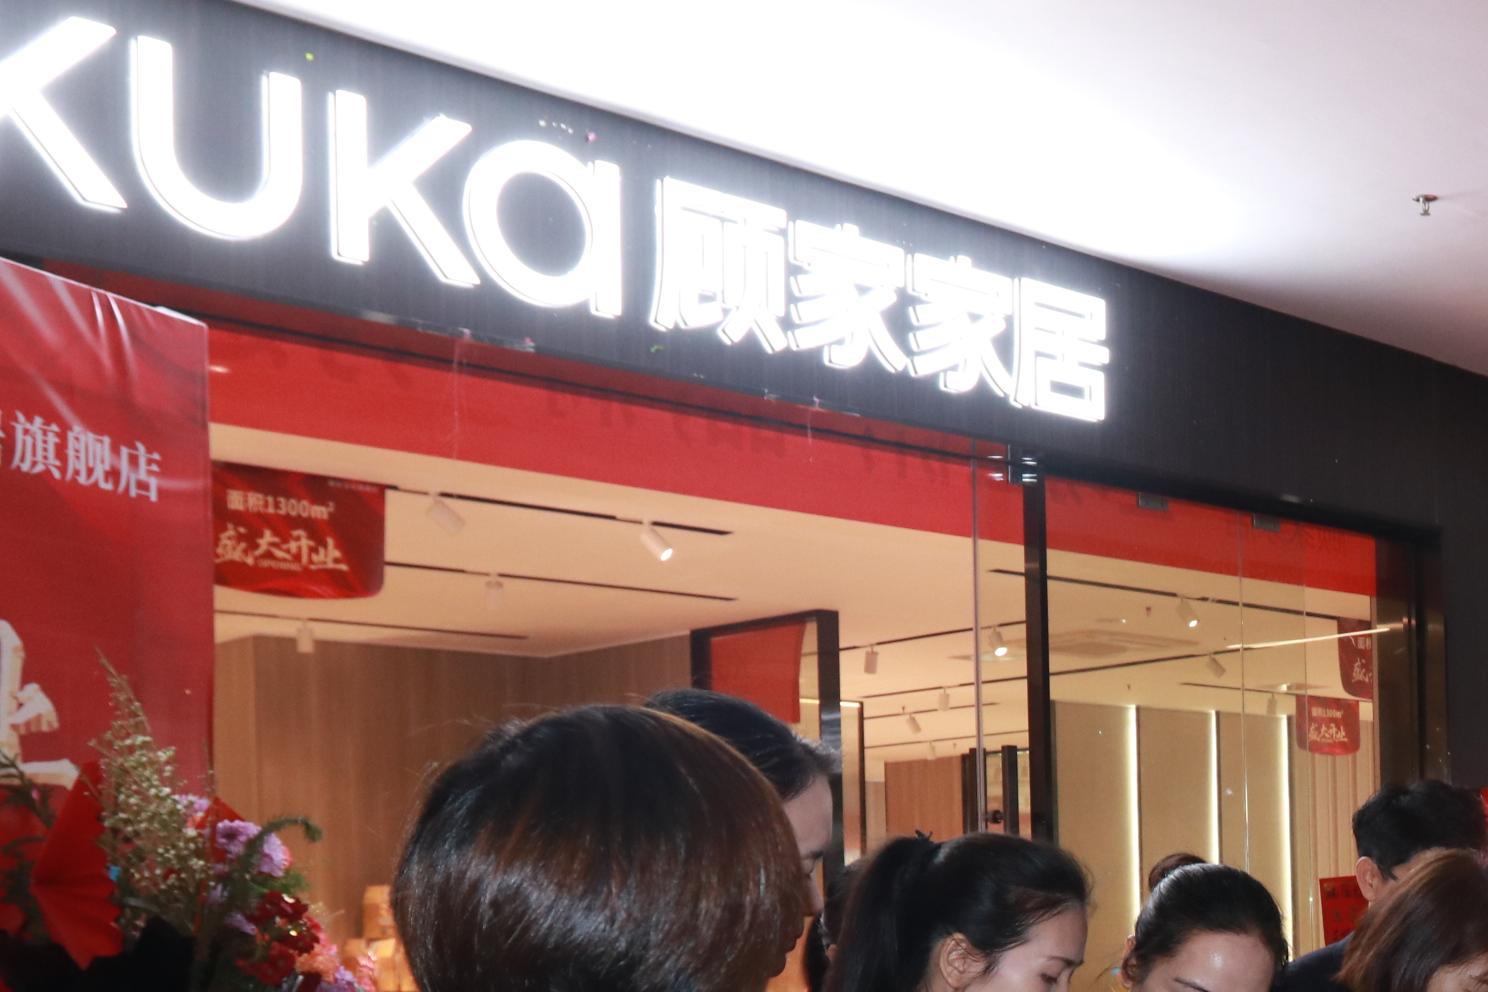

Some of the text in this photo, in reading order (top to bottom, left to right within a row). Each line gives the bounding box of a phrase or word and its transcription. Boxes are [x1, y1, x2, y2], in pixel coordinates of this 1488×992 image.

[650, 175, 1111, 423] 顾家家居
[0, 408, 163, 503] 旗舰店
[214, 522, 349, 572] 盛大开业
